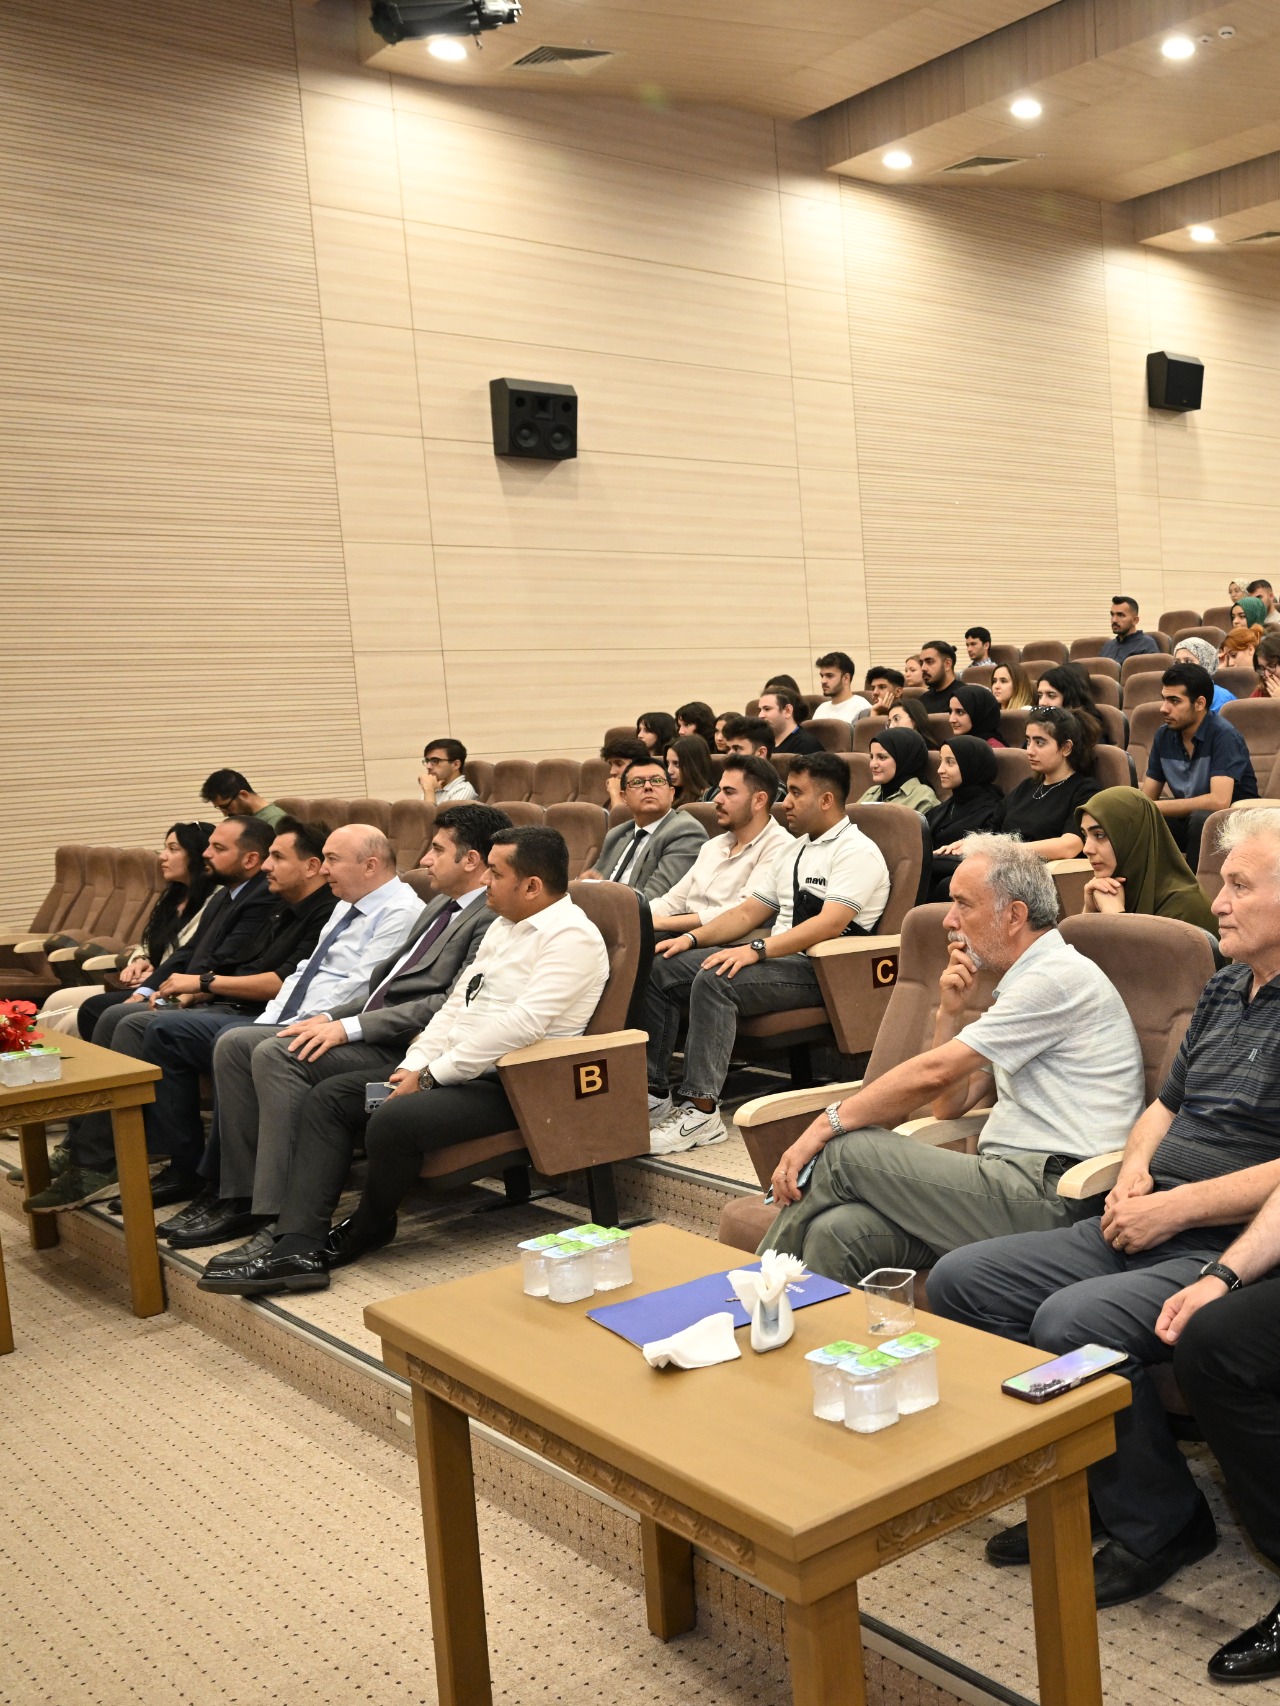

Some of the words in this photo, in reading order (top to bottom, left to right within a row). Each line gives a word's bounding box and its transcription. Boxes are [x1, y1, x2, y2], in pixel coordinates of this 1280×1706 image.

[805, 876, 826, 886] mavi
[877, 959, 894, 984] C
[579, 1065, 603, 1094] B
